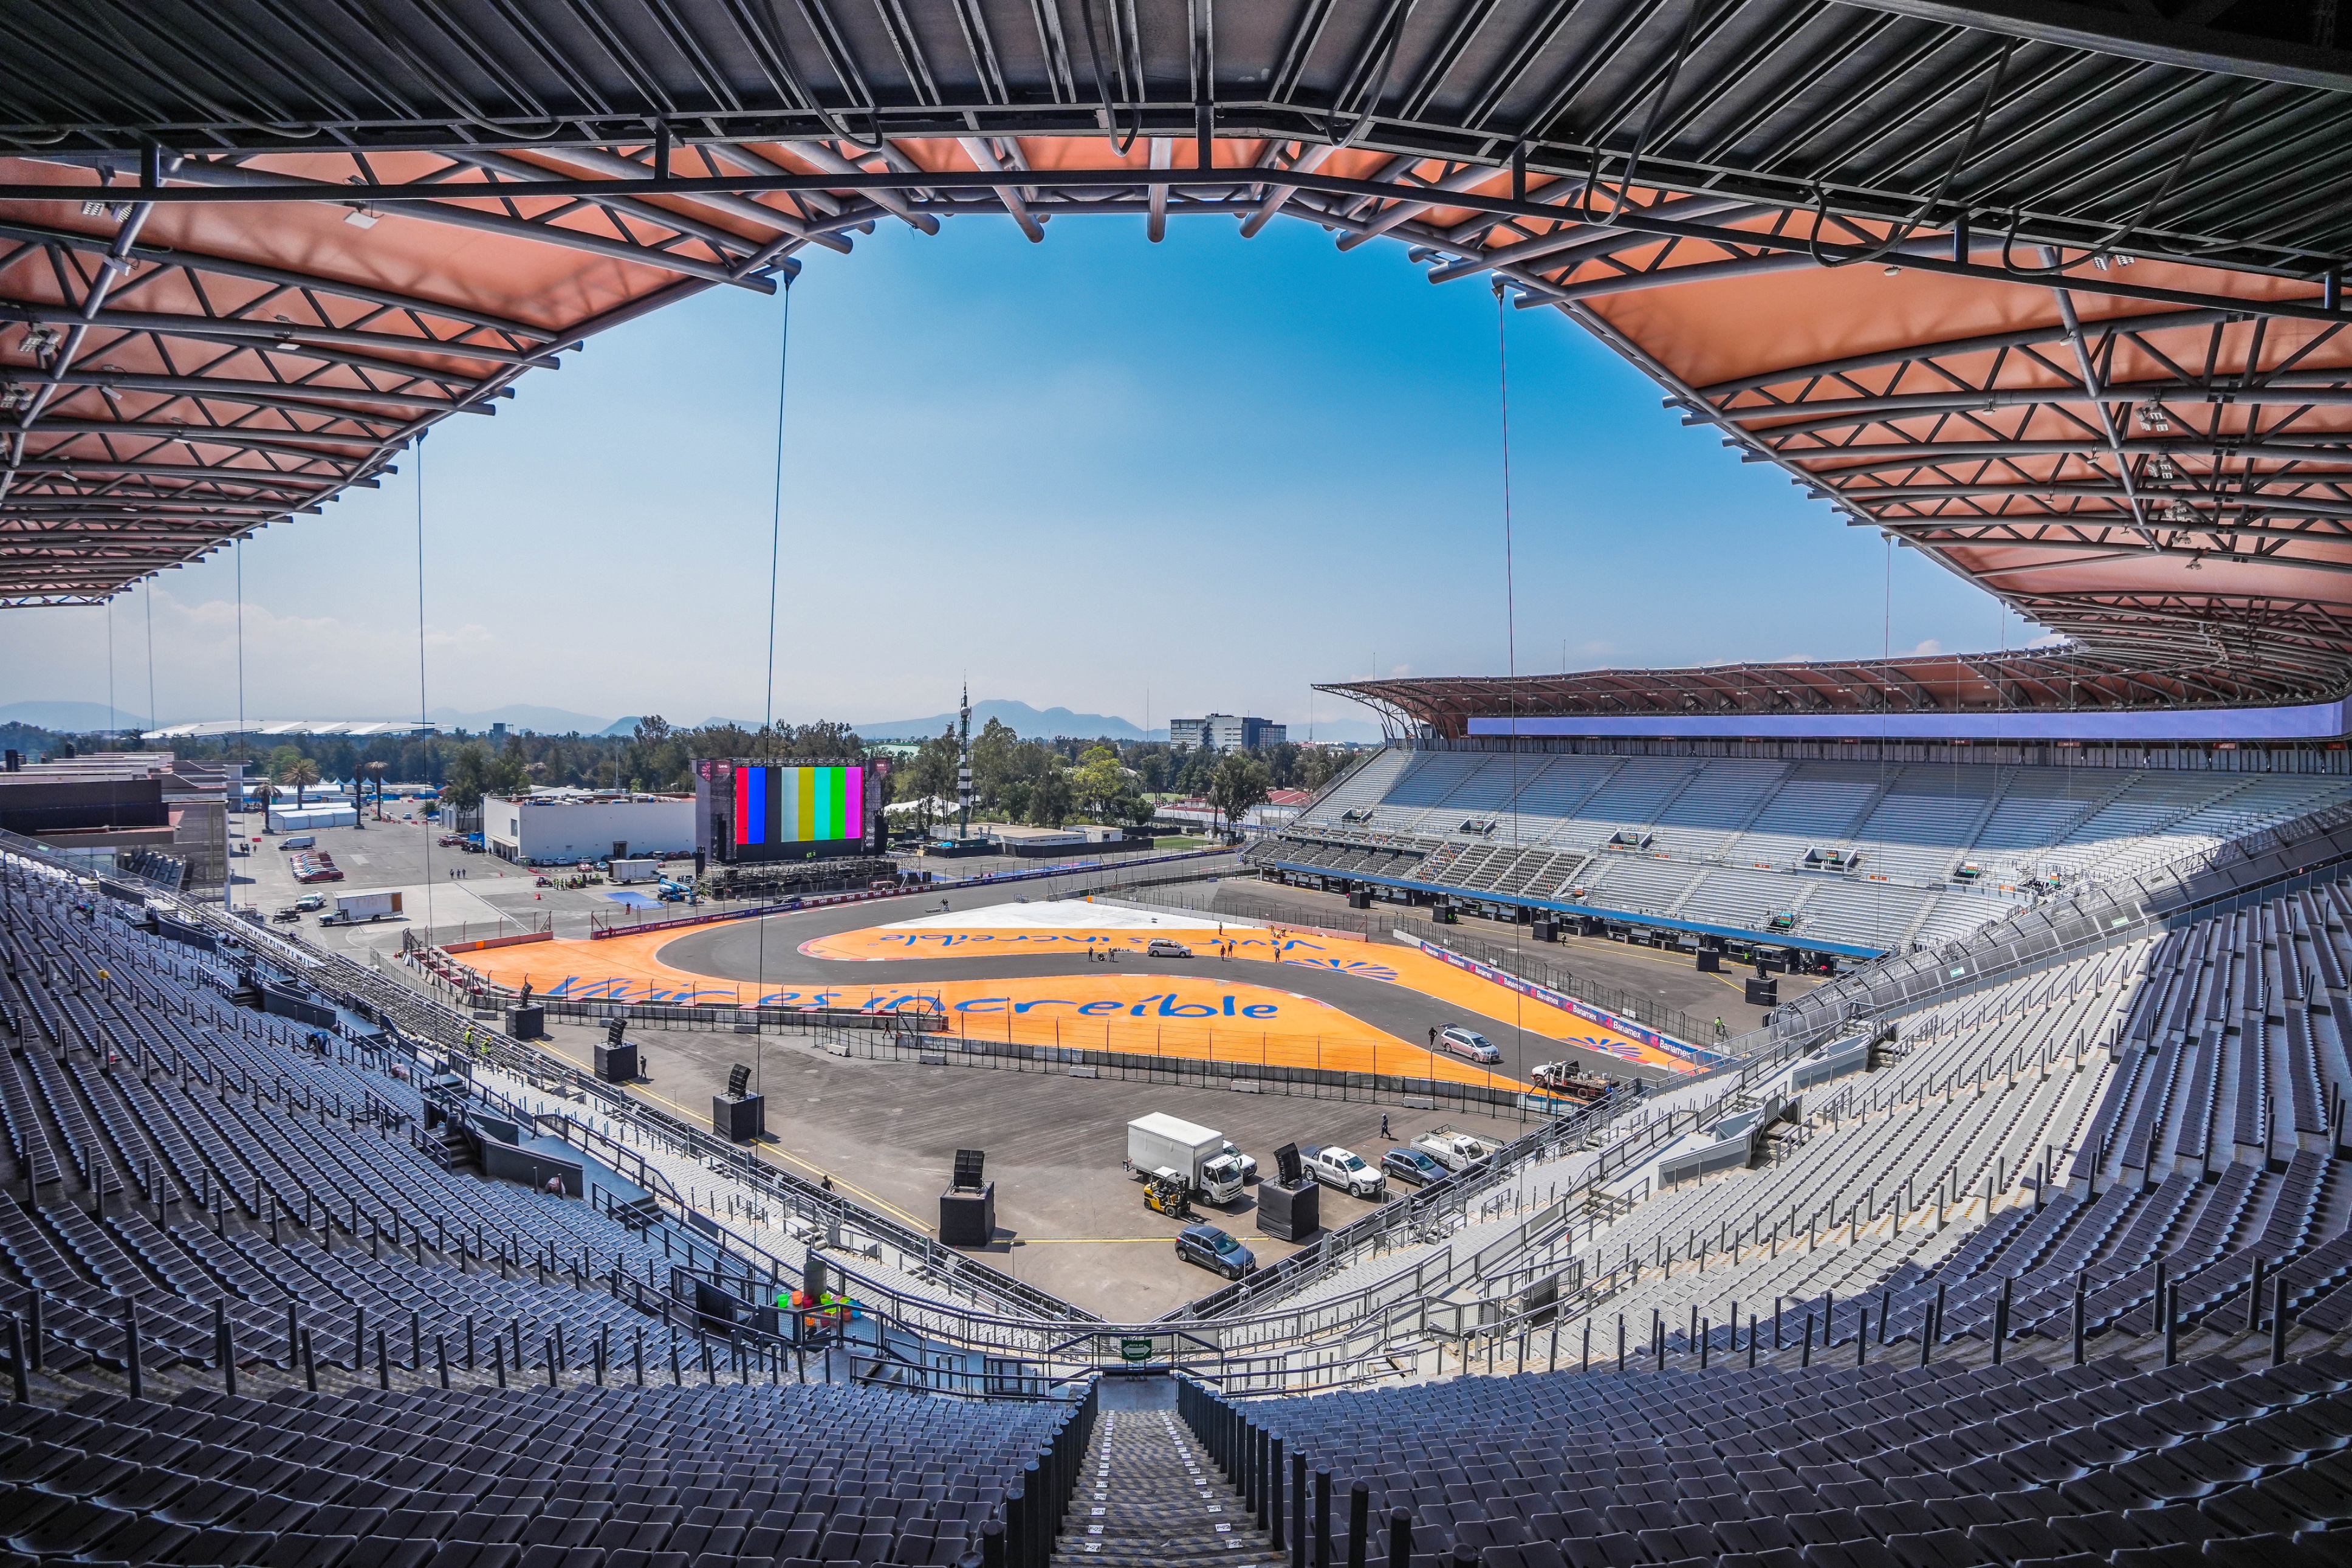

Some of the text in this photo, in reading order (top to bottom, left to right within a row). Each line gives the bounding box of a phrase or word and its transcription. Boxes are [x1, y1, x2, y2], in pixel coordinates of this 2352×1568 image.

[1425, 945, 1439, 957] Banamex
[1448, 955, 1465, 968] Banamex
[1475, 966, 1493, 979] Banamex
[758, 992, 842, 1007] es
[1537, 990, 1558, 1006] Banamex
[1573, 1005, 1597, 1022] Banamex
[1613, 1021, 1641, 1039] Banamex
[1659, 1040, 1692, 1059] Banamex
